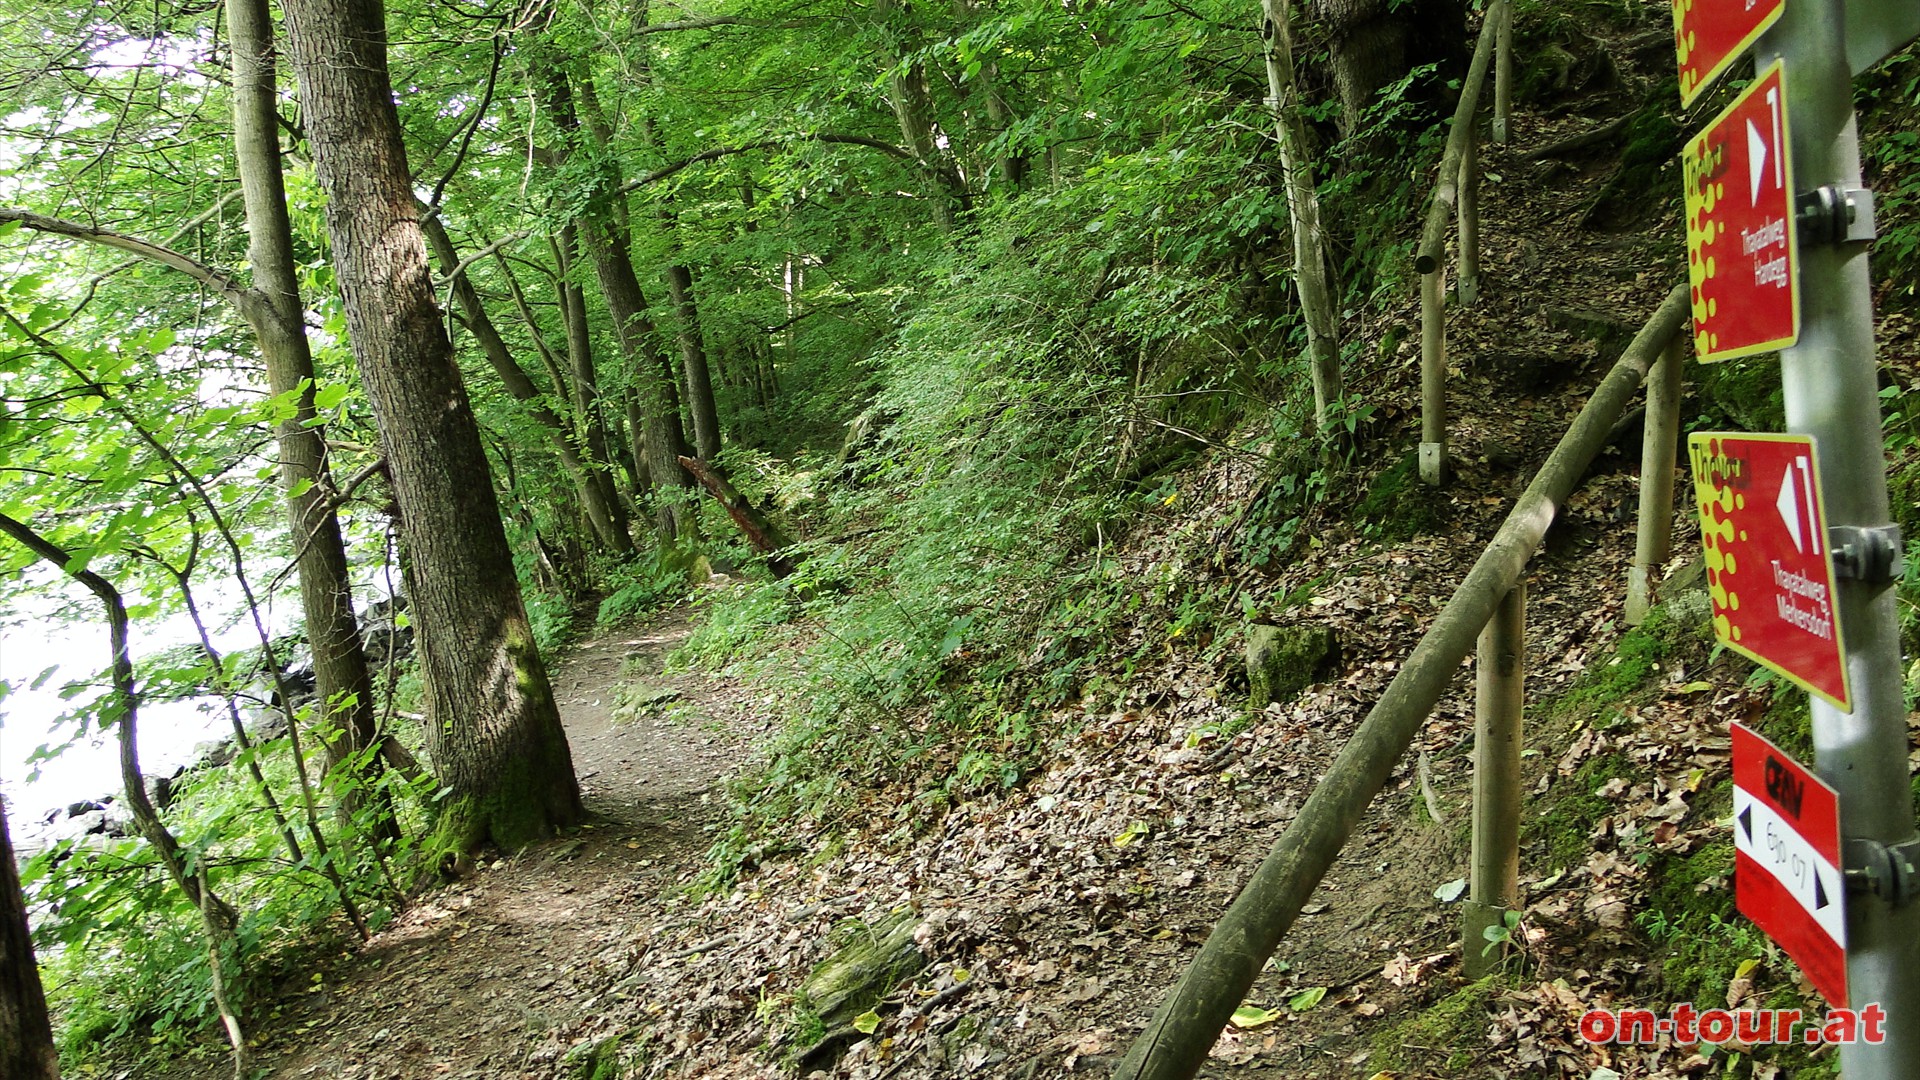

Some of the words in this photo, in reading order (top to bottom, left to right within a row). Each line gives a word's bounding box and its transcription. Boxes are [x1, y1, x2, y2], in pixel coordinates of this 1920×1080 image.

[1766, 86, 1782, 189] 1
[1796, 456, 1819, 555] 1
[1776, 593, 1832, 641] Merkersdorf
